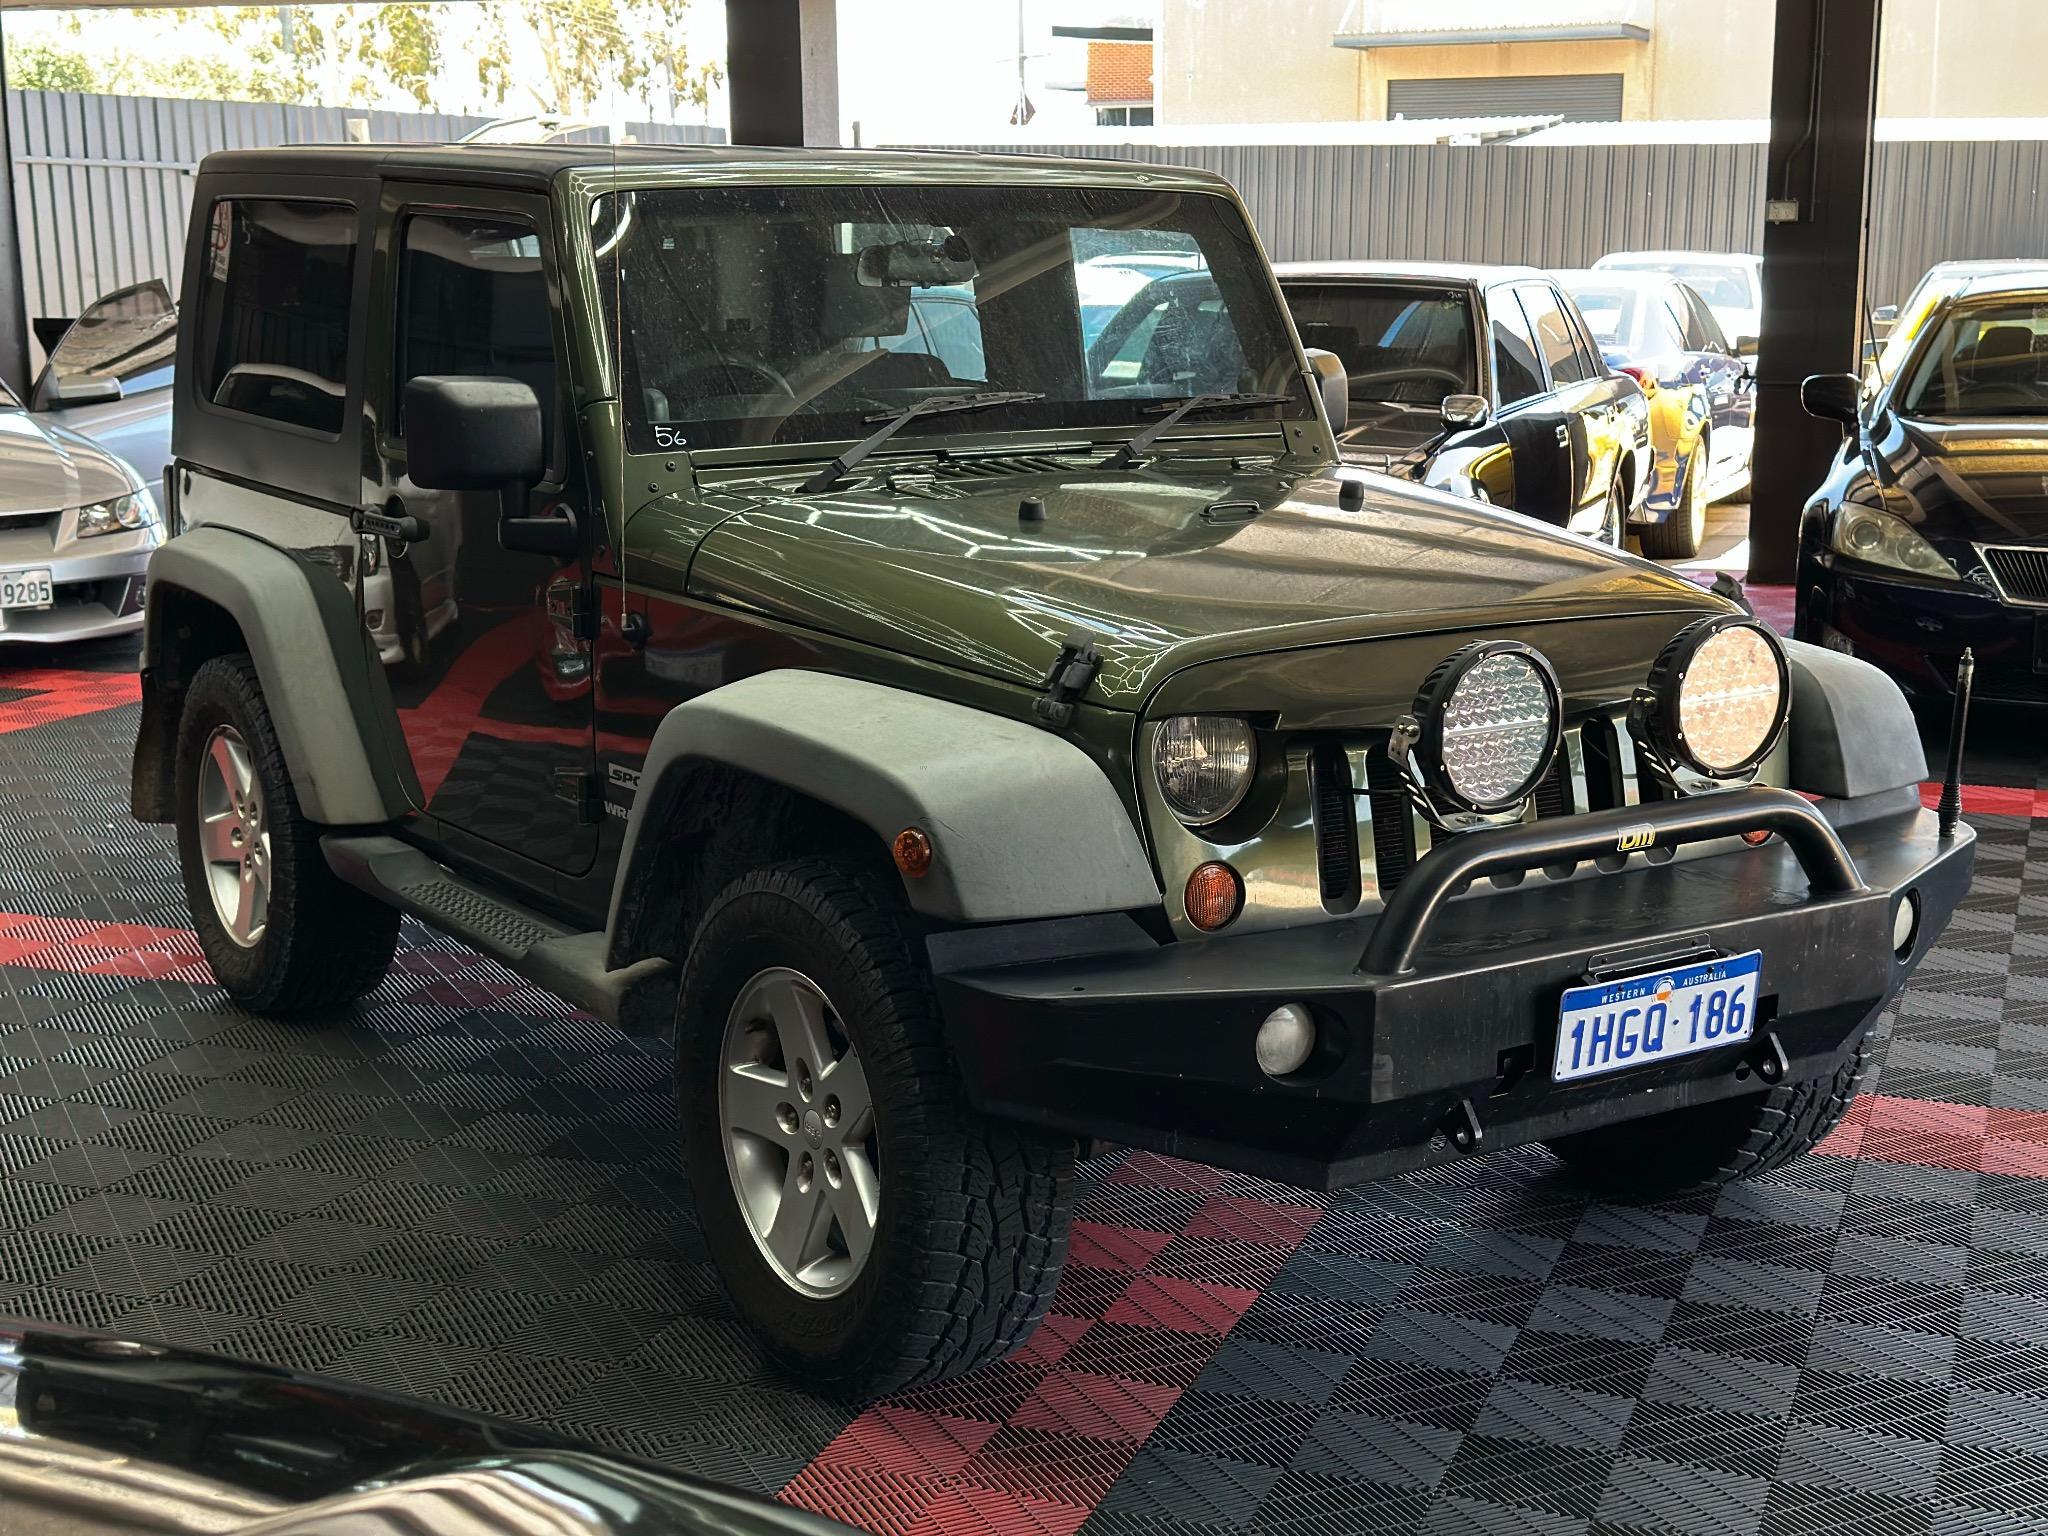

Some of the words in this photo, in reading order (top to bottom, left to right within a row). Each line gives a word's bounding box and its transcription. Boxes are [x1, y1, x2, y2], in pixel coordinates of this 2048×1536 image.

[655, 425, 687, 447] 56
[0, 581, 50, 604] 9285
[1600, 987, 1646, 1004] WESTERN
[1682, 970, 1727, 987] AUSTRALIA
